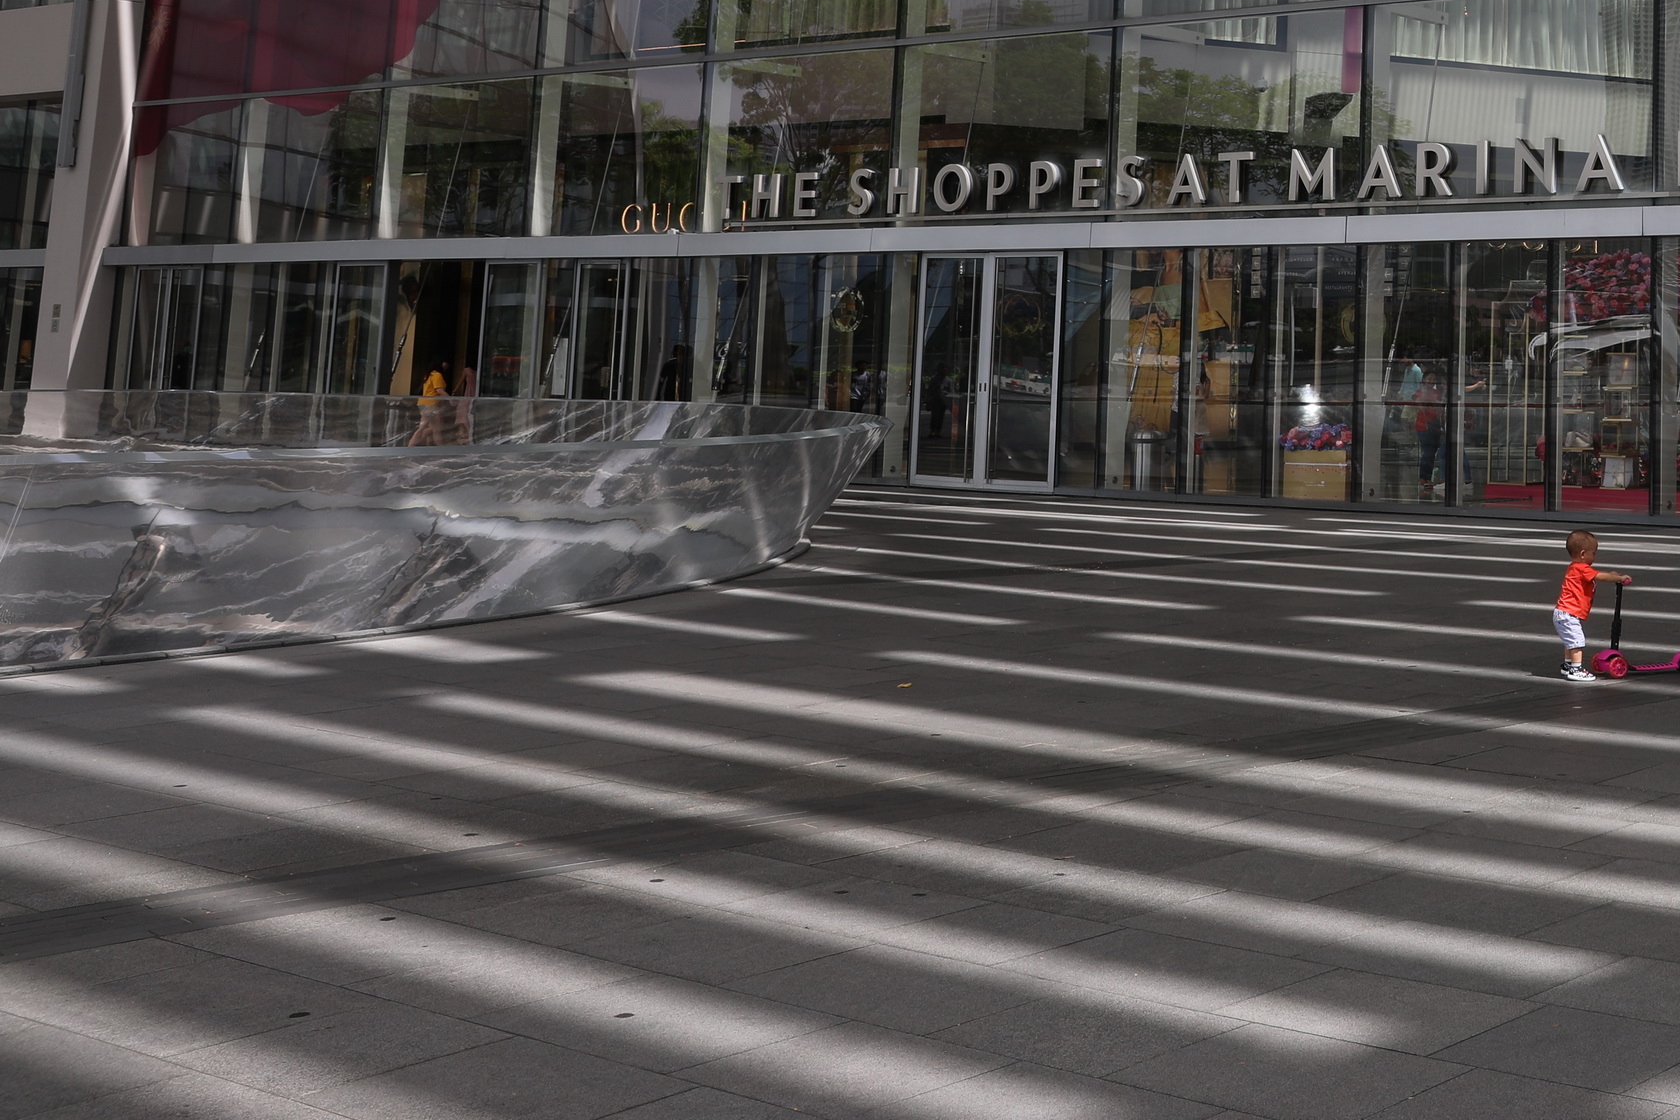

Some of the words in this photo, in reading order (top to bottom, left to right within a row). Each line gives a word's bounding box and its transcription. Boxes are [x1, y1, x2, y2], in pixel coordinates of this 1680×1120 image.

[717, 171, 822, 221] THE
[848, 154, 1147, 216] SHOPPES
[1166, 150, 1254, 206] AT
[1287, 132, 1624, 202] MARINA
[621, 200, 748, 234] GUCI
